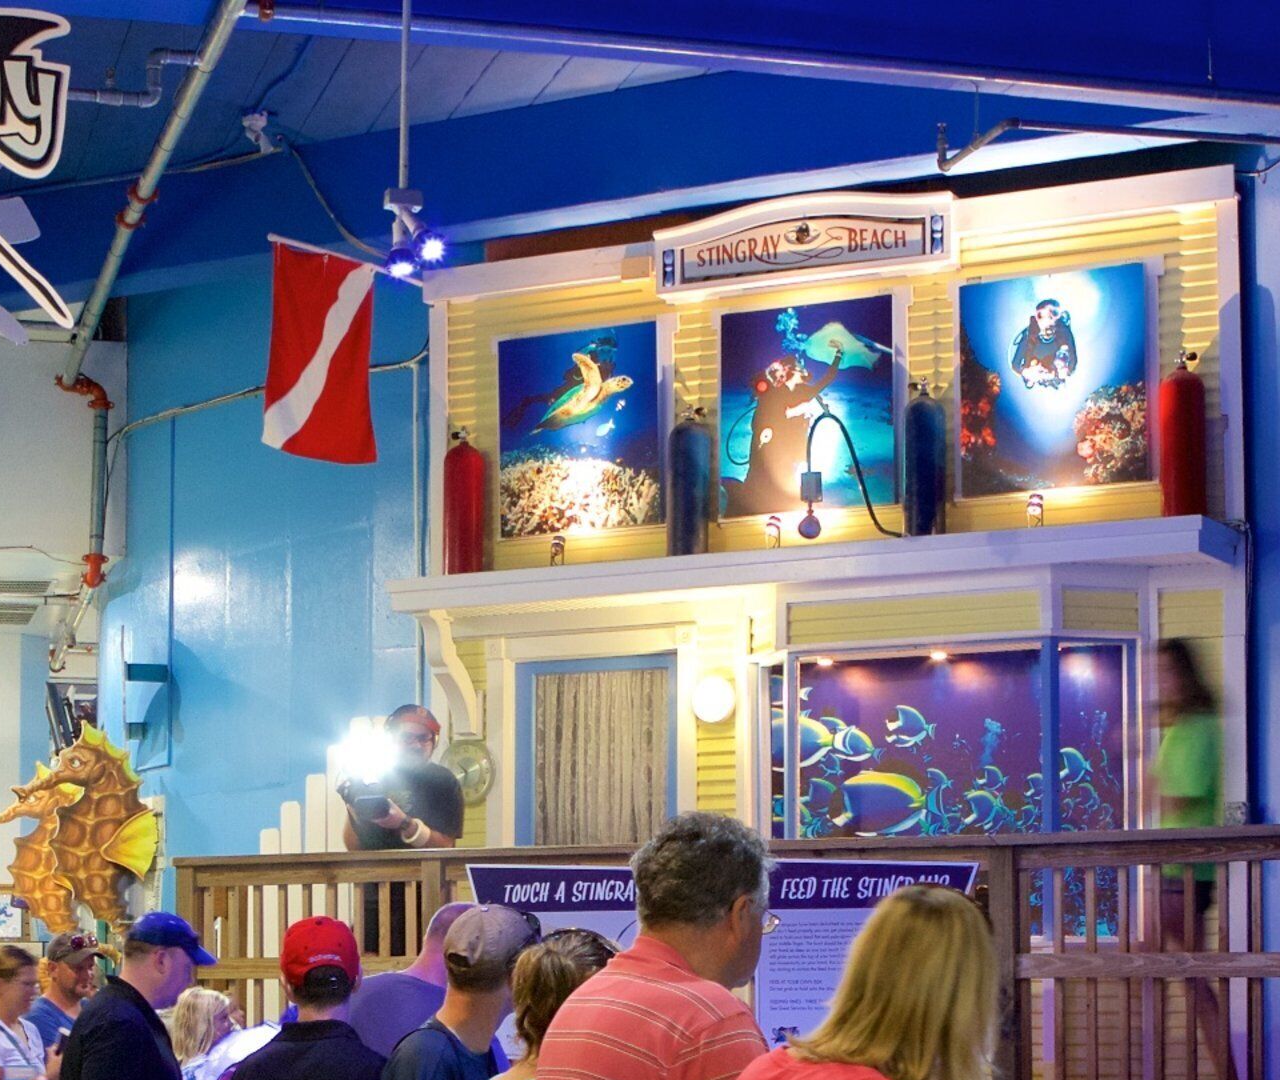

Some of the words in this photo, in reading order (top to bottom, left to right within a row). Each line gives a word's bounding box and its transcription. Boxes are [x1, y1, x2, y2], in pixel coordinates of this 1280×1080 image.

[696, 235, 780, 267] STINGRAY
[848, 228, 906, 253] BEACH
[504, 882, 550, 903] TOUCH
[554, 881, 565, 903] A
[571, 879, 634, 903] STINGRA
[780, 877, 817, 900] FEED
[822, 877, 852, 898] THE
